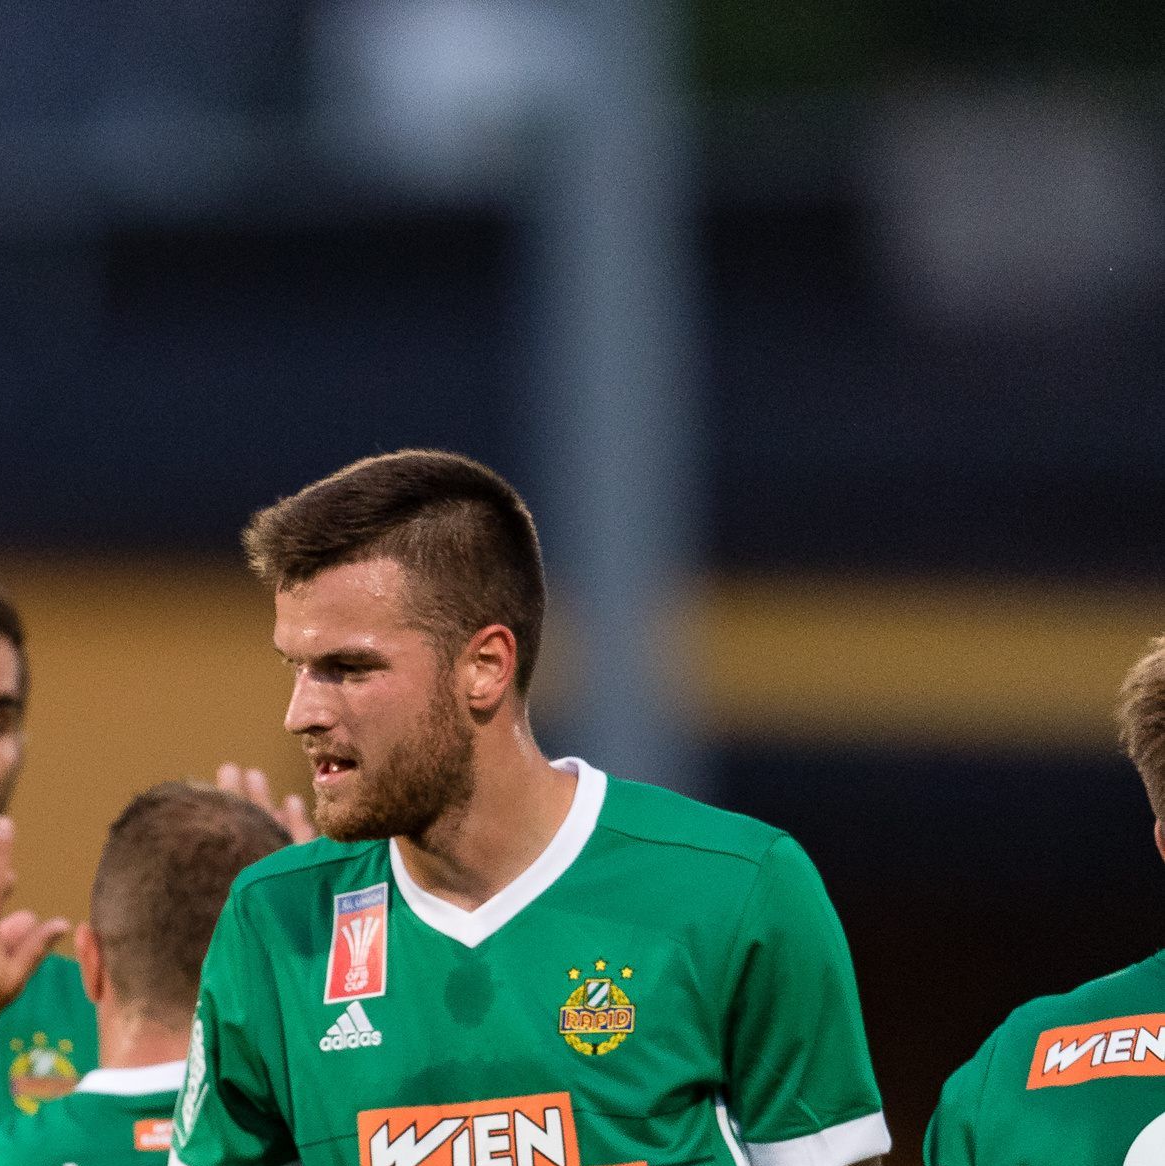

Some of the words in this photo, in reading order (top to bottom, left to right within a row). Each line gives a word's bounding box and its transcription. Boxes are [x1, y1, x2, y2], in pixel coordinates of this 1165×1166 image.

[565, 1008, 631, 1030] RAPID
[319, 1030, 383, 1051] adidas
[1041, 1026, 1165, 1077] WIEN
